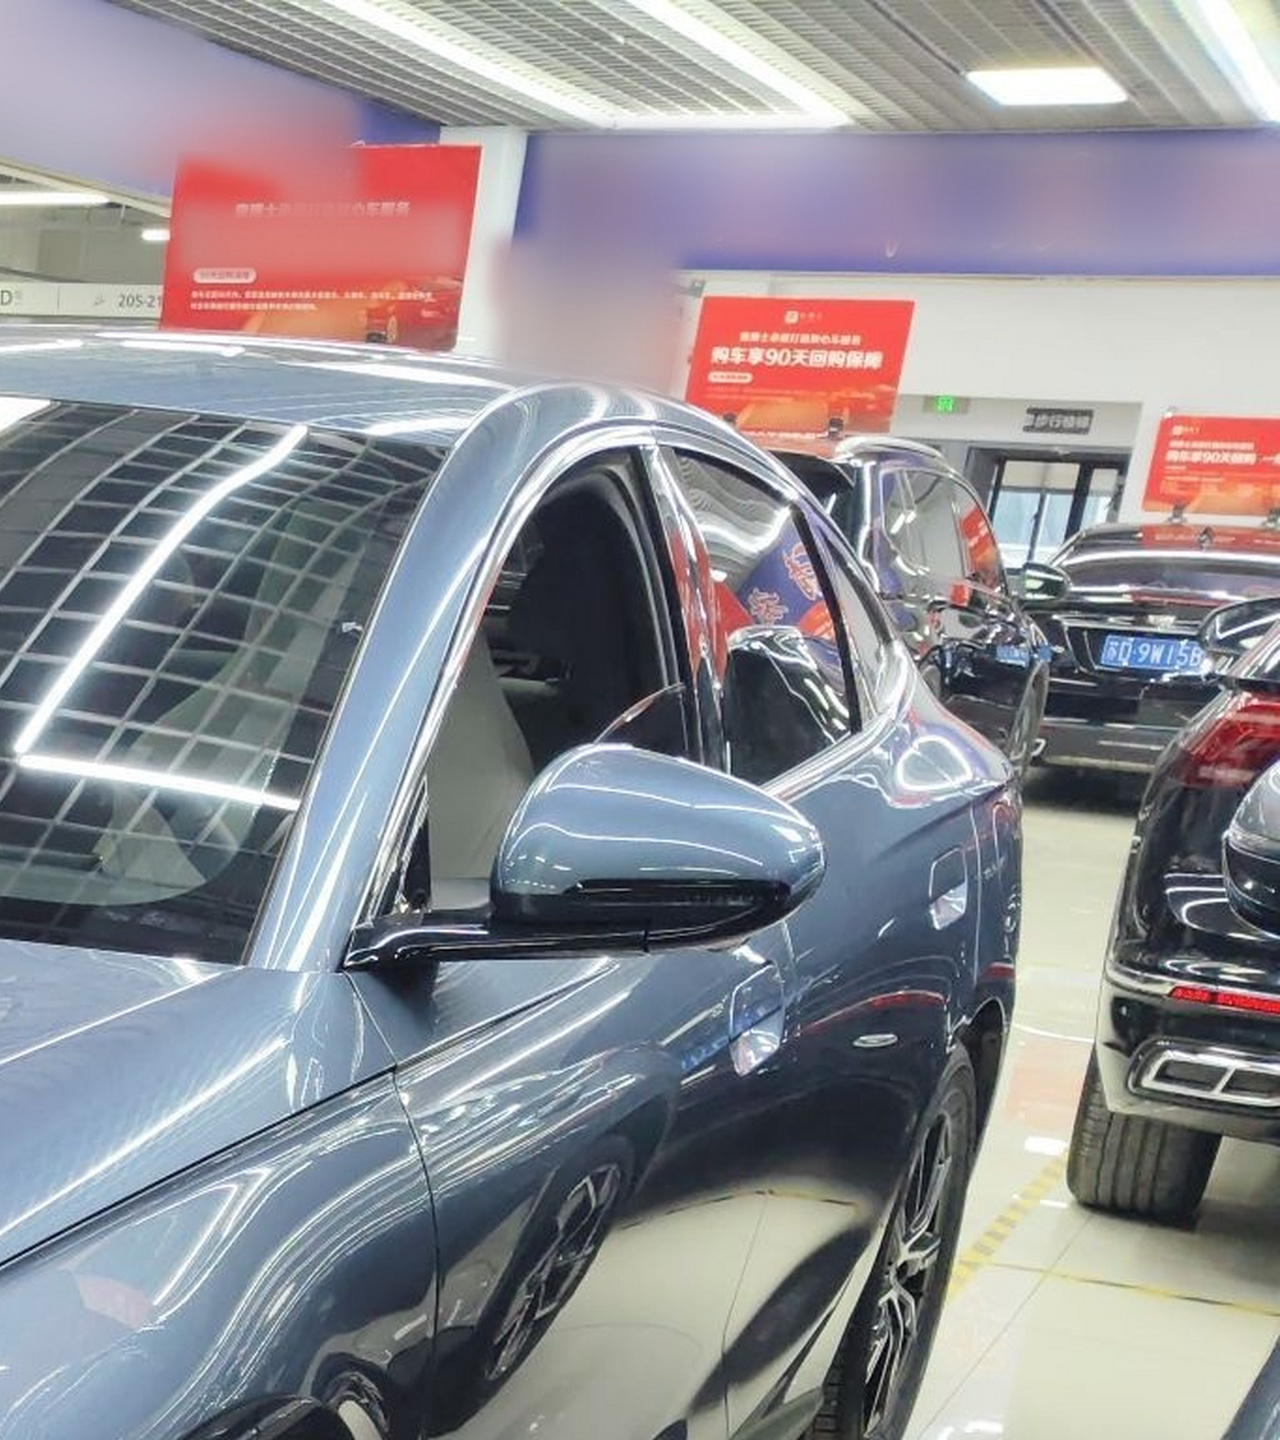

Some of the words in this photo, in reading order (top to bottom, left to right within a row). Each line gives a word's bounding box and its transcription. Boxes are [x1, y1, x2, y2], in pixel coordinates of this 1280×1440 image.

[710, 345, 883, 370] 购车享90天回购保障
